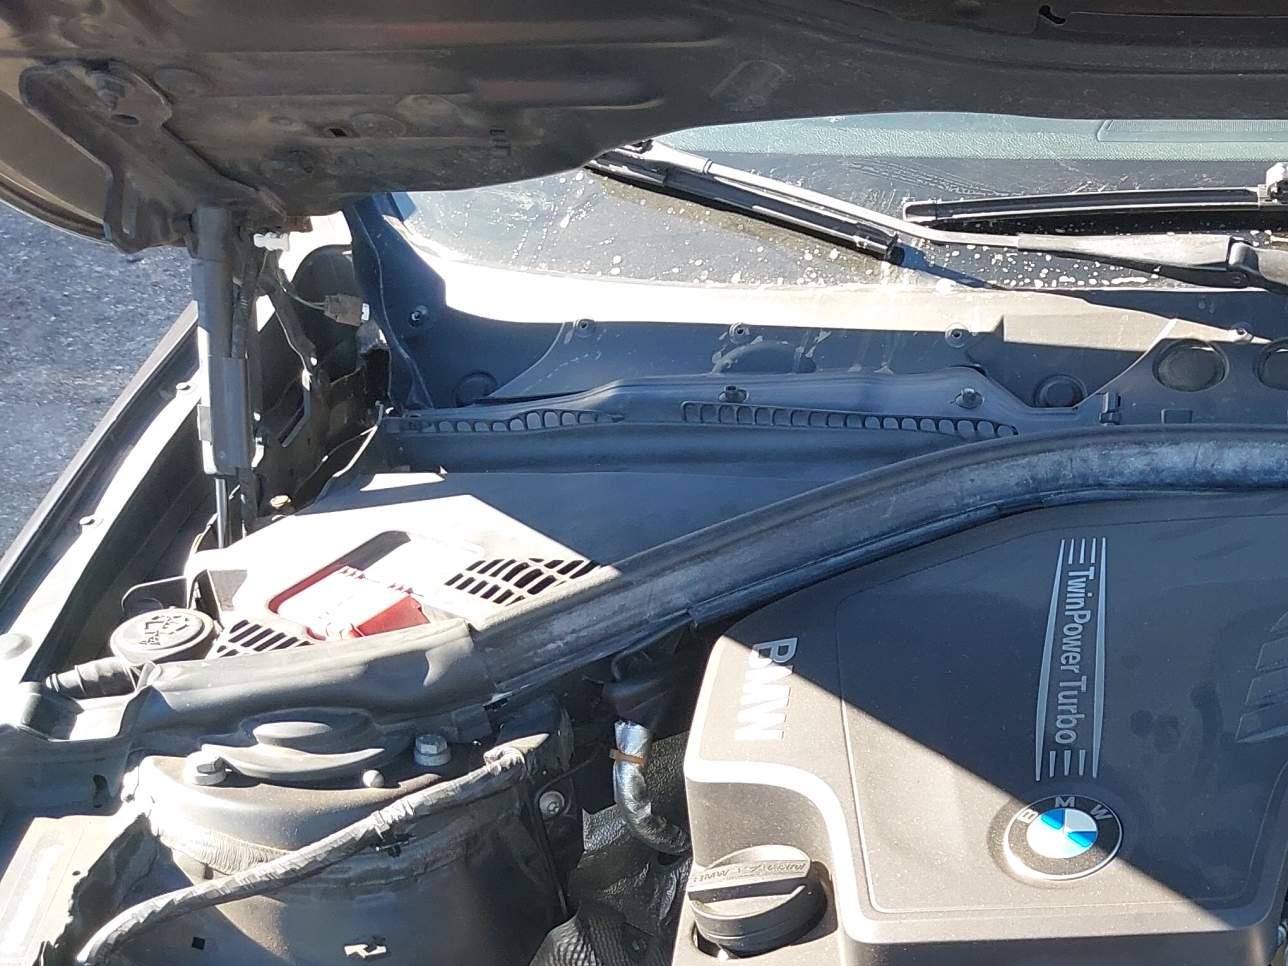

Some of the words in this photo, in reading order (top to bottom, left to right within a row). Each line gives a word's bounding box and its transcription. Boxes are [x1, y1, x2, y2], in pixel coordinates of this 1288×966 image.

[1060, 566, 1095, 673] TwinPower
[736, 637, 798, 741] BMW
[1055, 675, 1087, 745] Turbo
[1017, 796, 1112, 824] BMW
